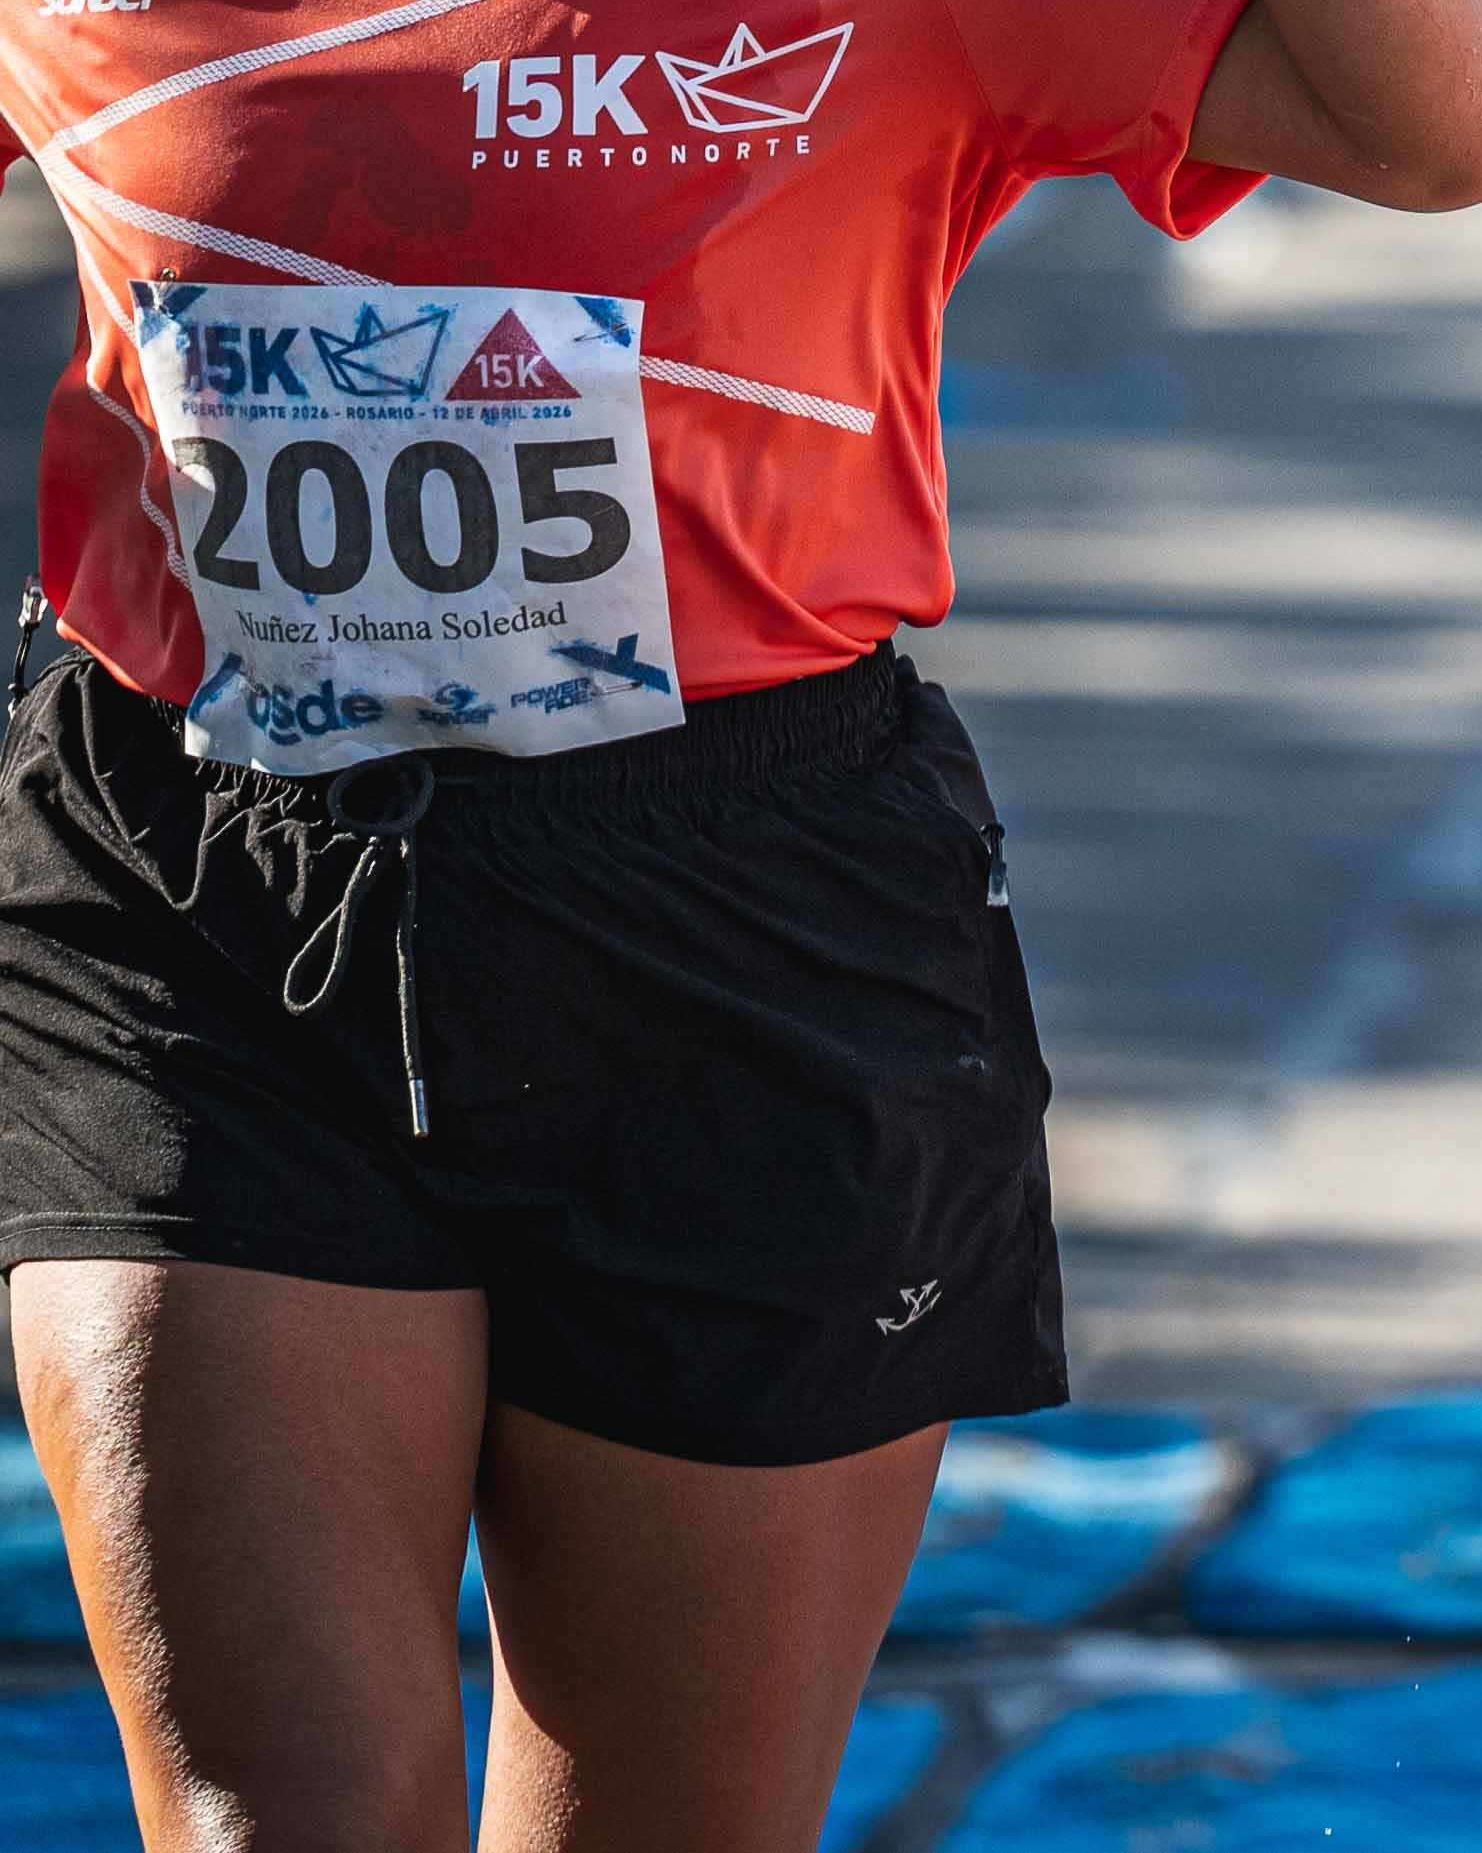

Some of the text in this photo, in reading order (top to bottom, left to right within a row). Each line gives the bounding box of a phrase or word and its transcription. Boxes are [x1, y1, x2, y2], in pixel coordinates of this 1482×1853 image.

[462, 53, 649, 140] 15K
[474, 353, 545, 389] 15K
[181, 402, 235, 419] PUERTO
[240, 406, 287, 420] NORTE
[292, 406, 329, 420] 2026
[346, 406, 414, 421] ROSARIO
[432, 406, 449, 421] 12
[454, 406, 475, 421] DE
[532, 405, 572, 420] 2026
[172, 437, 631, 596] 2005
[235, 601, 568, 645] Nuñez Johana Soledad
[510, 676, 591, 709] POWER
